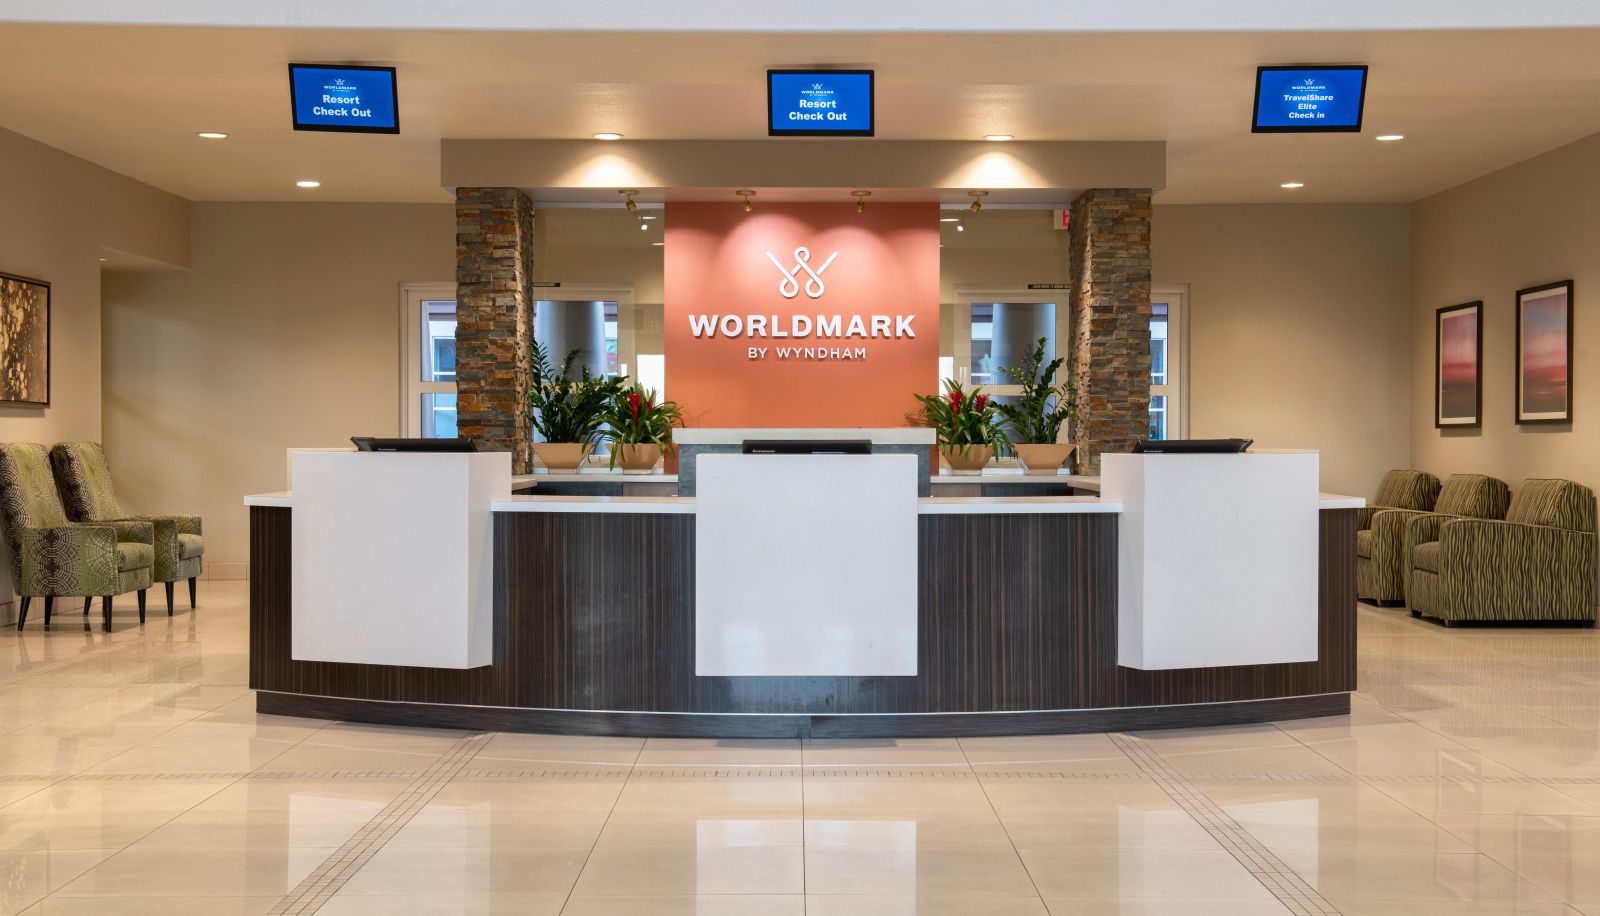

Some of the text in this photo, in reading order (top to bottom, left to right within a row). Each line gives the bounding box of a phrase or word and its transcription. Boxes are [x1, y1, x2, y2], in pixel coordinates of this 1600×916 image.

[322, 94, 360, 104] Resort
[799, 99, 837, 108] Resort
[313, 106, 372, 117] Check Out
[788, 111, 847, 120] Check Out
[688, 314, 916, 338] WORLDMARK
[748, 347, 867, 359] BY WYNDHAM
